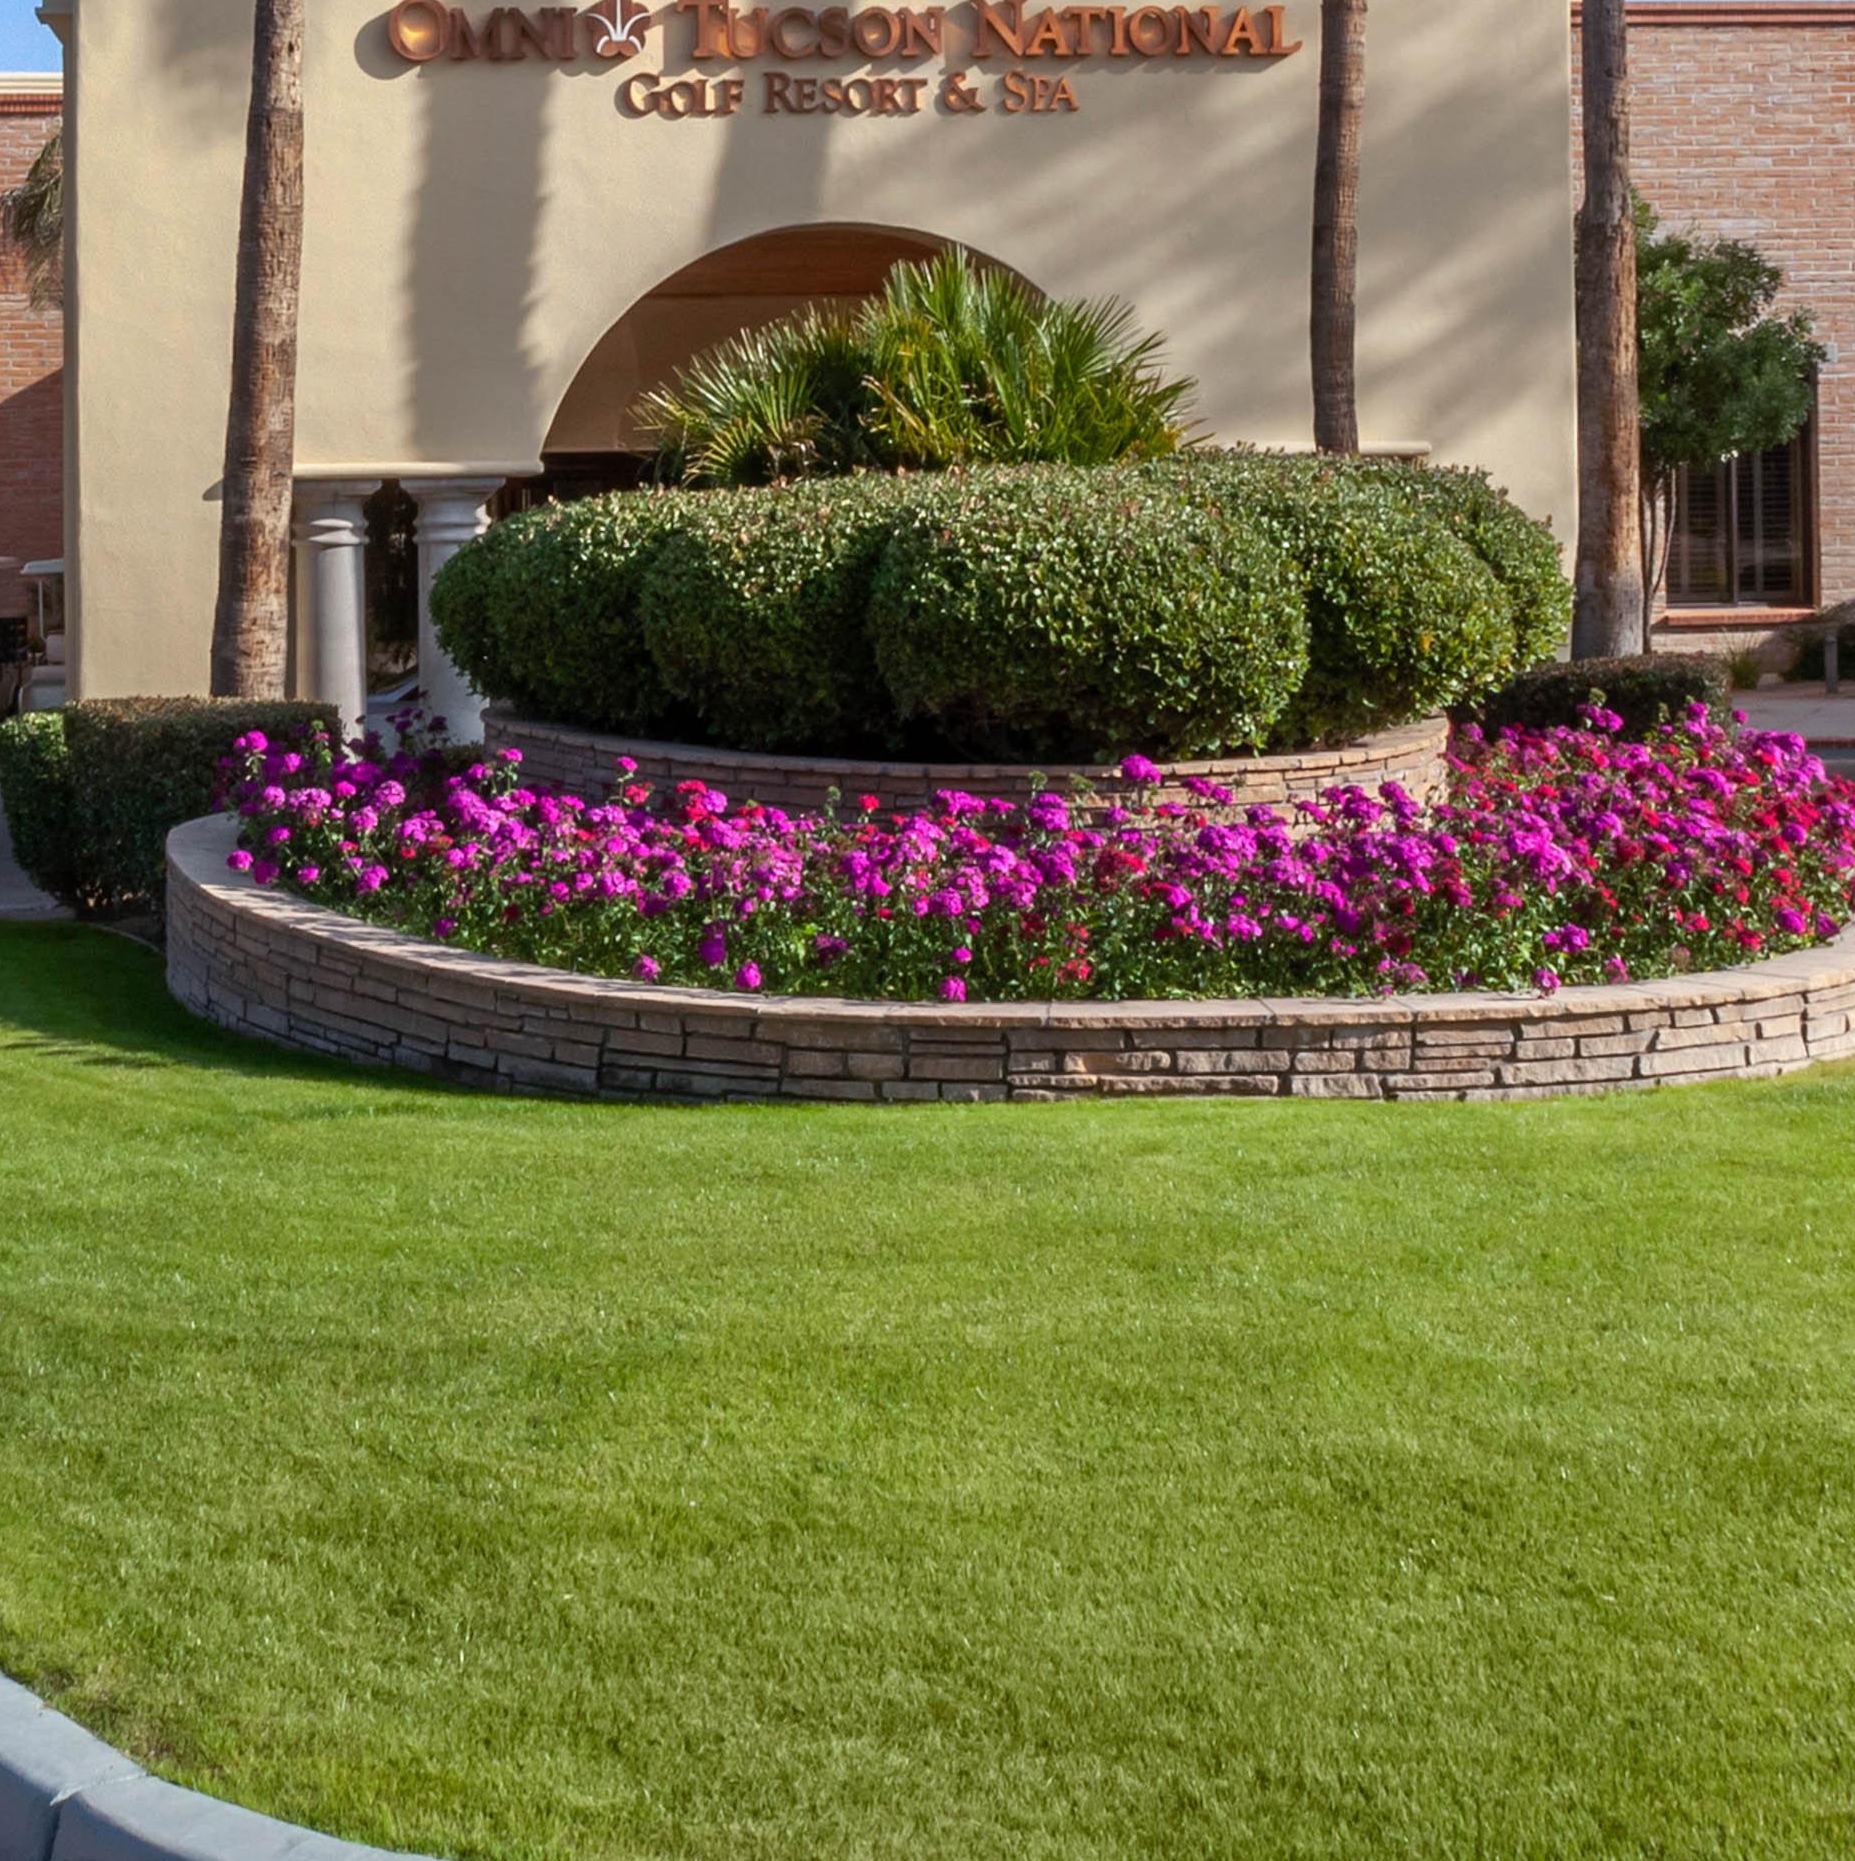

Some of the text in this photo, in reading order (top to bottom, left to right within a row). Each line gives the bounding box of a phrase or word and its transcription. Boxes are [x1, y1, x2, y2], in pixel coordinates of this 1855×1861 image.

[624, 71, 1079, 116] GOLF RESORT & SPA
